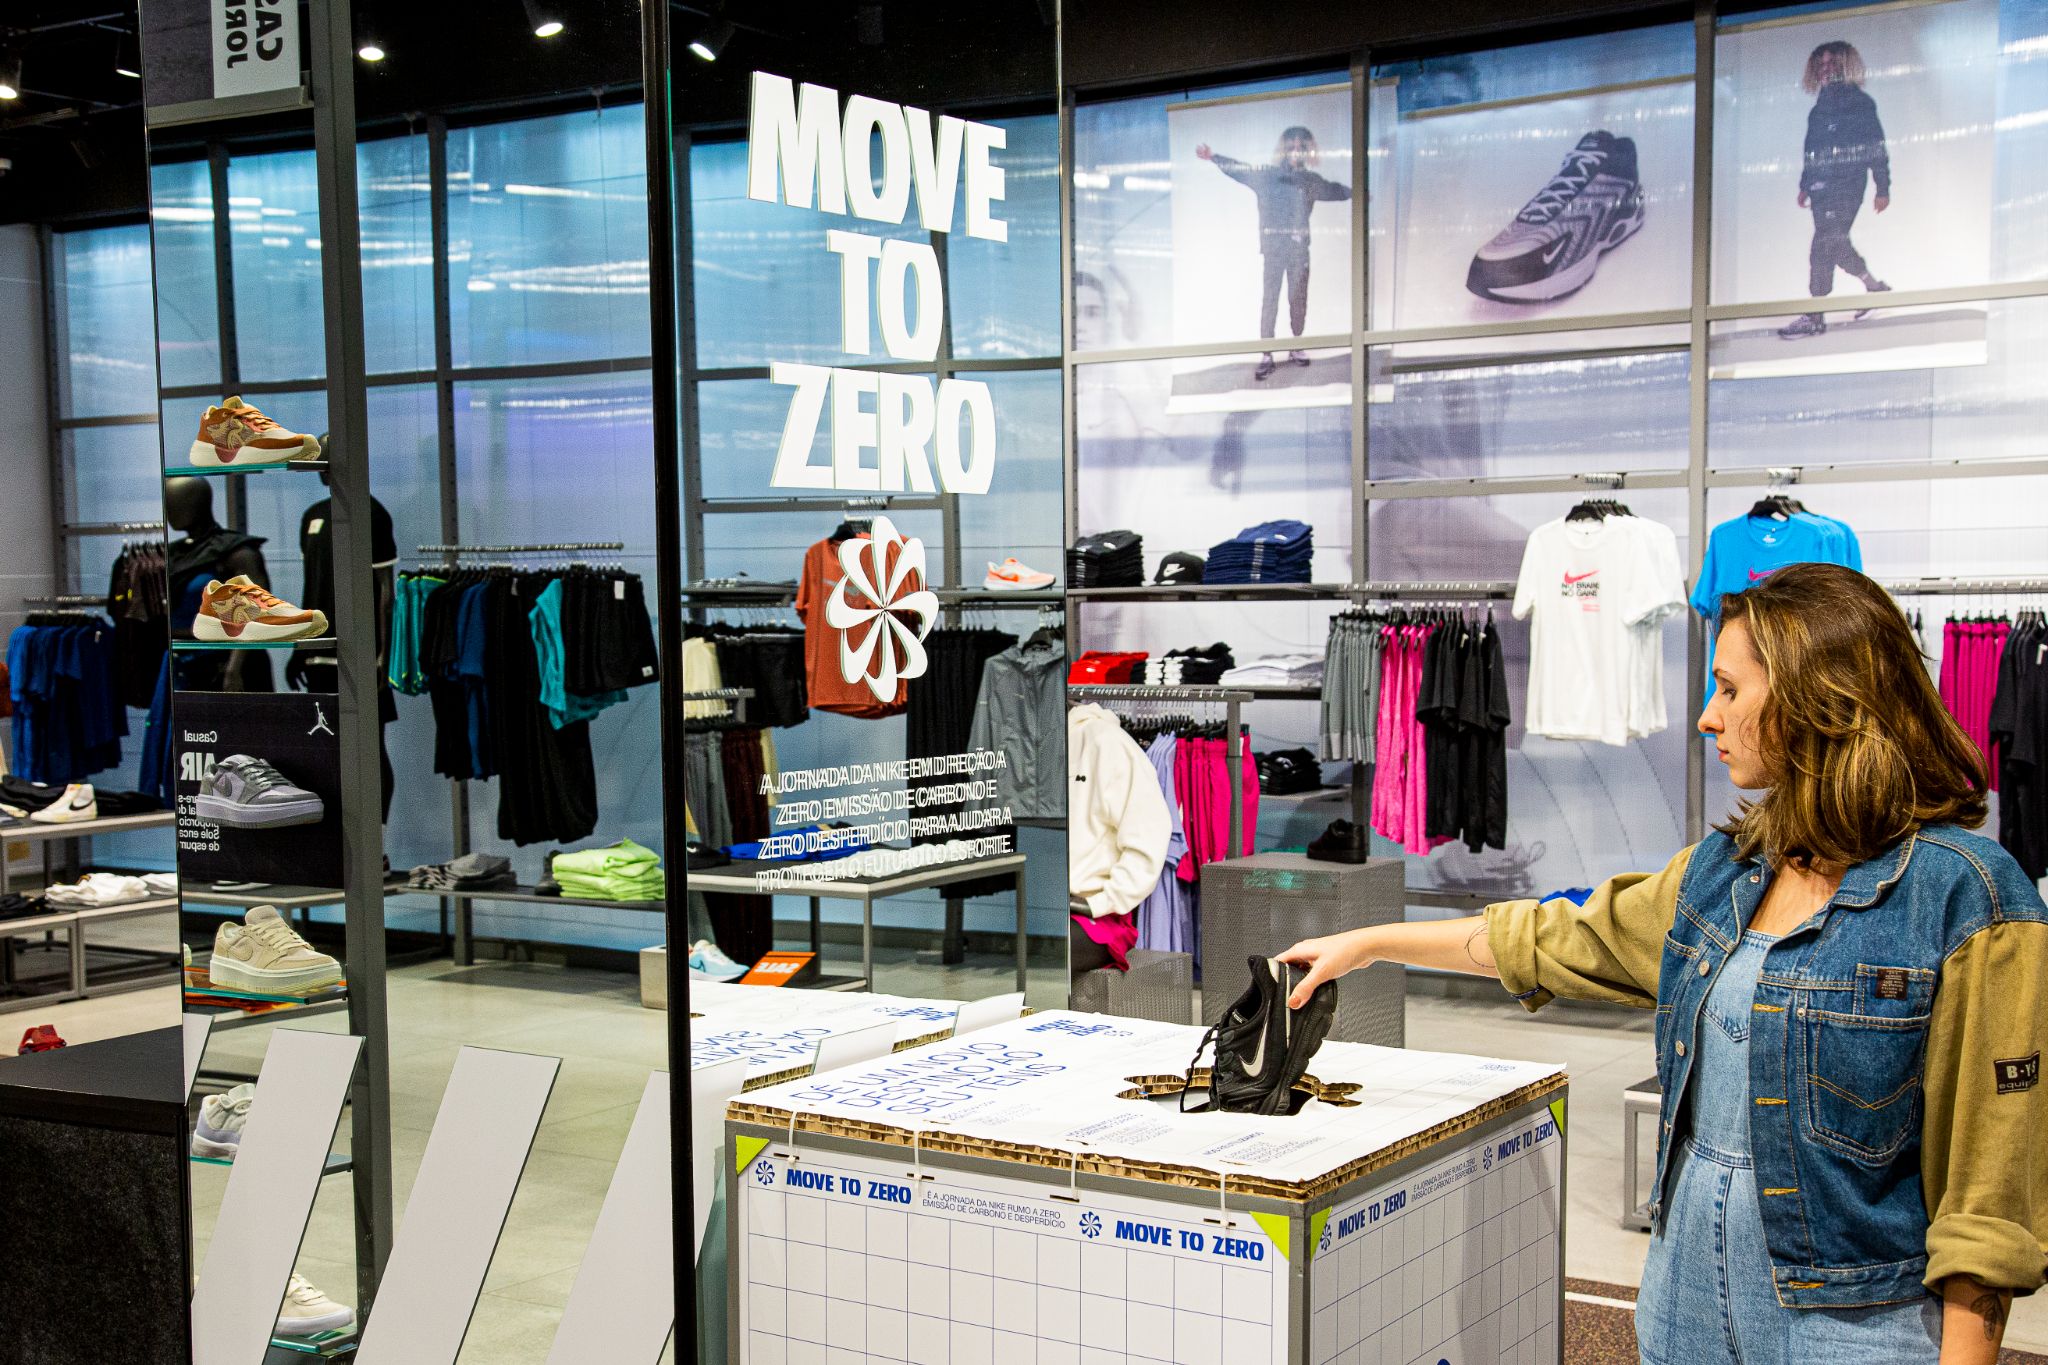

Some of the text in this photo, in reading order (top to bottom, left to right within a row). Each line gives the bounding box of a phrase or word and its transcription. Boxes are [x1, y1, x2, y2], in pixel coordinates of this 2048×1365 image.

[748, 71, 1008, 243] MOVE
[827, 229, 944, 361] TO
[769, 362, 997, 495] ZERO
[774, 765, 851, 793] JORNADA
[876, 760, 910, 782] NIKE
[775, 779, 998, 826] ZERO EMISSÃO DE CARBONO E
[757, 834, 806, 860] ZERO
[806, 816, 909, 853] DESPERDÍCIO
[790, 1042, 1008, 1101] DÉ UM NOVO
[837, 1051, 1044, 1108] DESTINO AO
[886, 1091, 973, 1115] SEU
[1497, 1120, 1554, 1161] MOVE TO ZERO
[786, 1168, 912, 1205] MOVE TO ZERO
[933, 1192, 939, 1201] A
[940, 1193, 975, 1206] JORNADA
[976, 1198, 988, 1208] DA
[988, 1200, 1006, 1211] NIKE
[1007, 1203, 1031, 1215] RUMO
[1032, 1208, 1038, 1216] A
[1039, 1208, 1061, 1220] ZERO
[922, 1197, 1066, 1229] EMISSÃO DE CARBONO E DESPERDÍCIO
[1338, 1189, 1407, 1240] MOVE TO ZERO
[1115, 1220, 1265, 1262] MOVE TO ZERO
